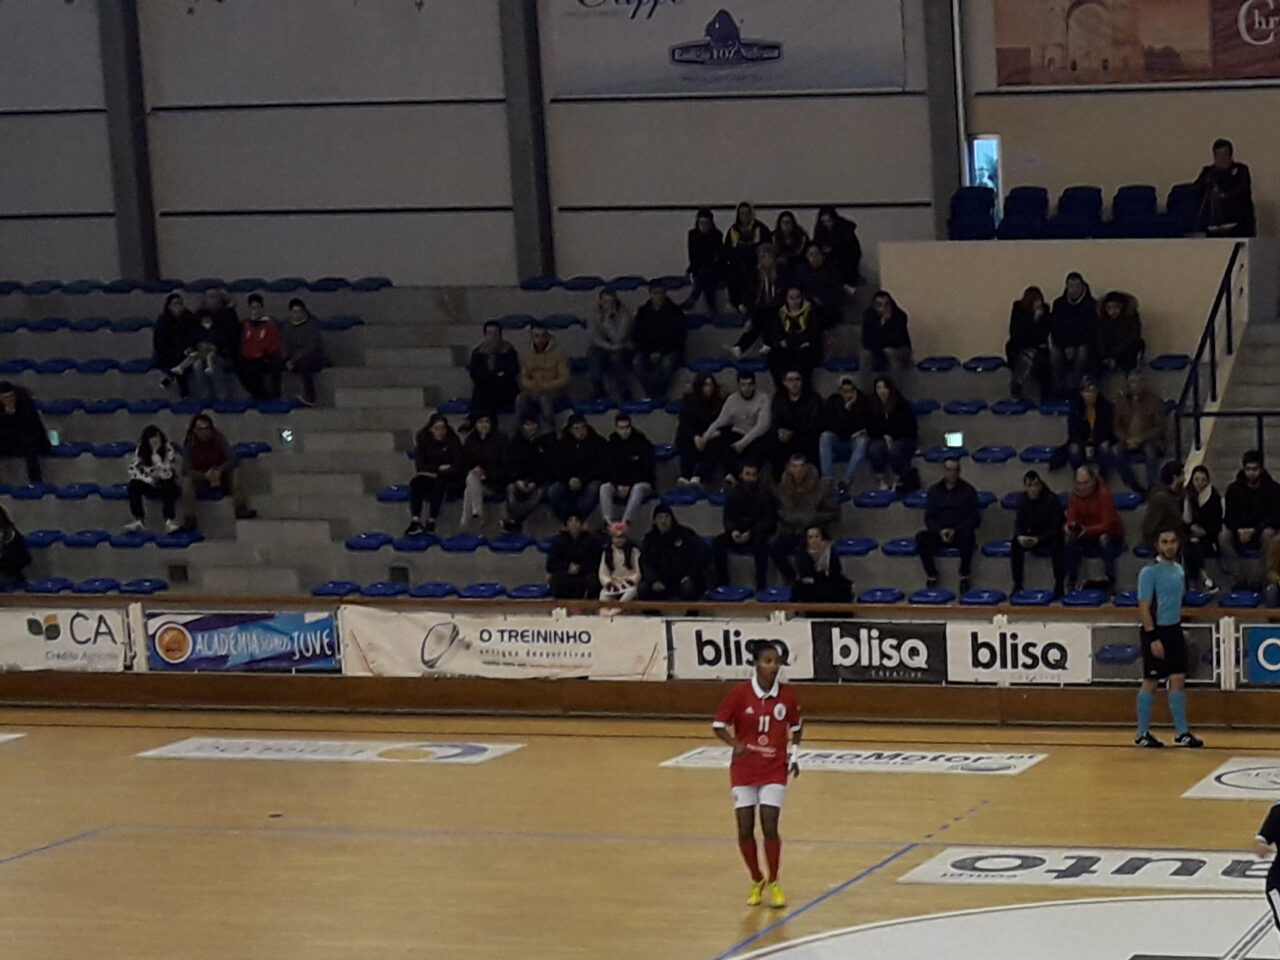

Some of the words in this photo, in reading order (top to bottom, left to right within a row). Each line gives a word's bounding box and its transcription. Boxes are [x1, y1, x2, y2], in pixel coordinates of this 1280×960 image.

[69, 611, 118, 645] CA
[479, 628, 493, 642] O
[497, 629, 592, 645] TREININHO
[195, 631, 260, 655] ACADEMIA
[291, 628, 333, 661] JUVE
[757, 714, 771, 733] 11
